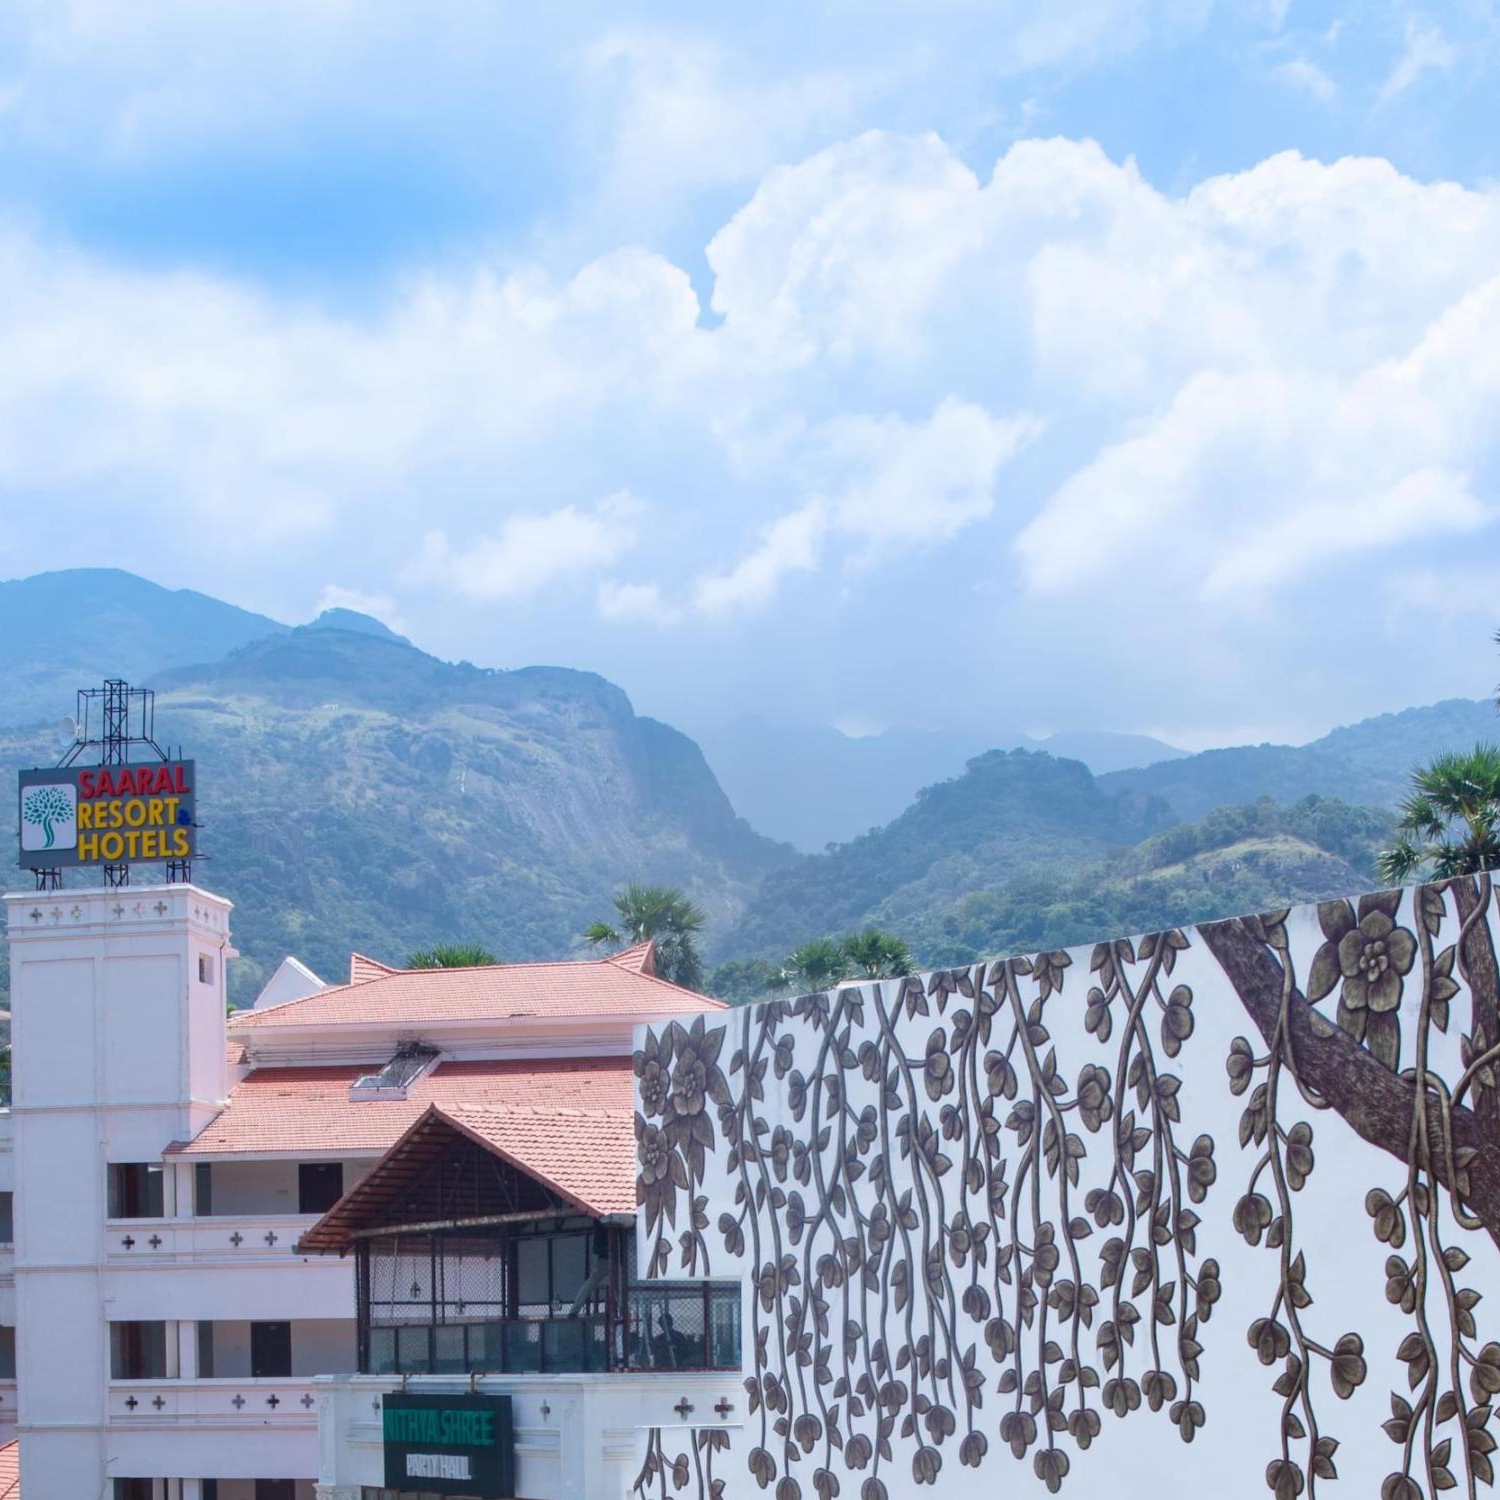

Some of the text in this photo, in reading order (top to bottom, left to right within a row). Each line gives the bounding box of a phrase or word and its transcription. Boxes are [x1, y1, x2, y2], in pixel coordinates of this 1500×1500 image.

[79, 766, 190, 799] SAARAL
[77, 797, 180, 830] RESORT
[78, 829, 190, 861] HOTELS
[384, 1408, 496, 1447] NITHYA SHREE
[406, 1453, 472, 1480] PARTY HALL
